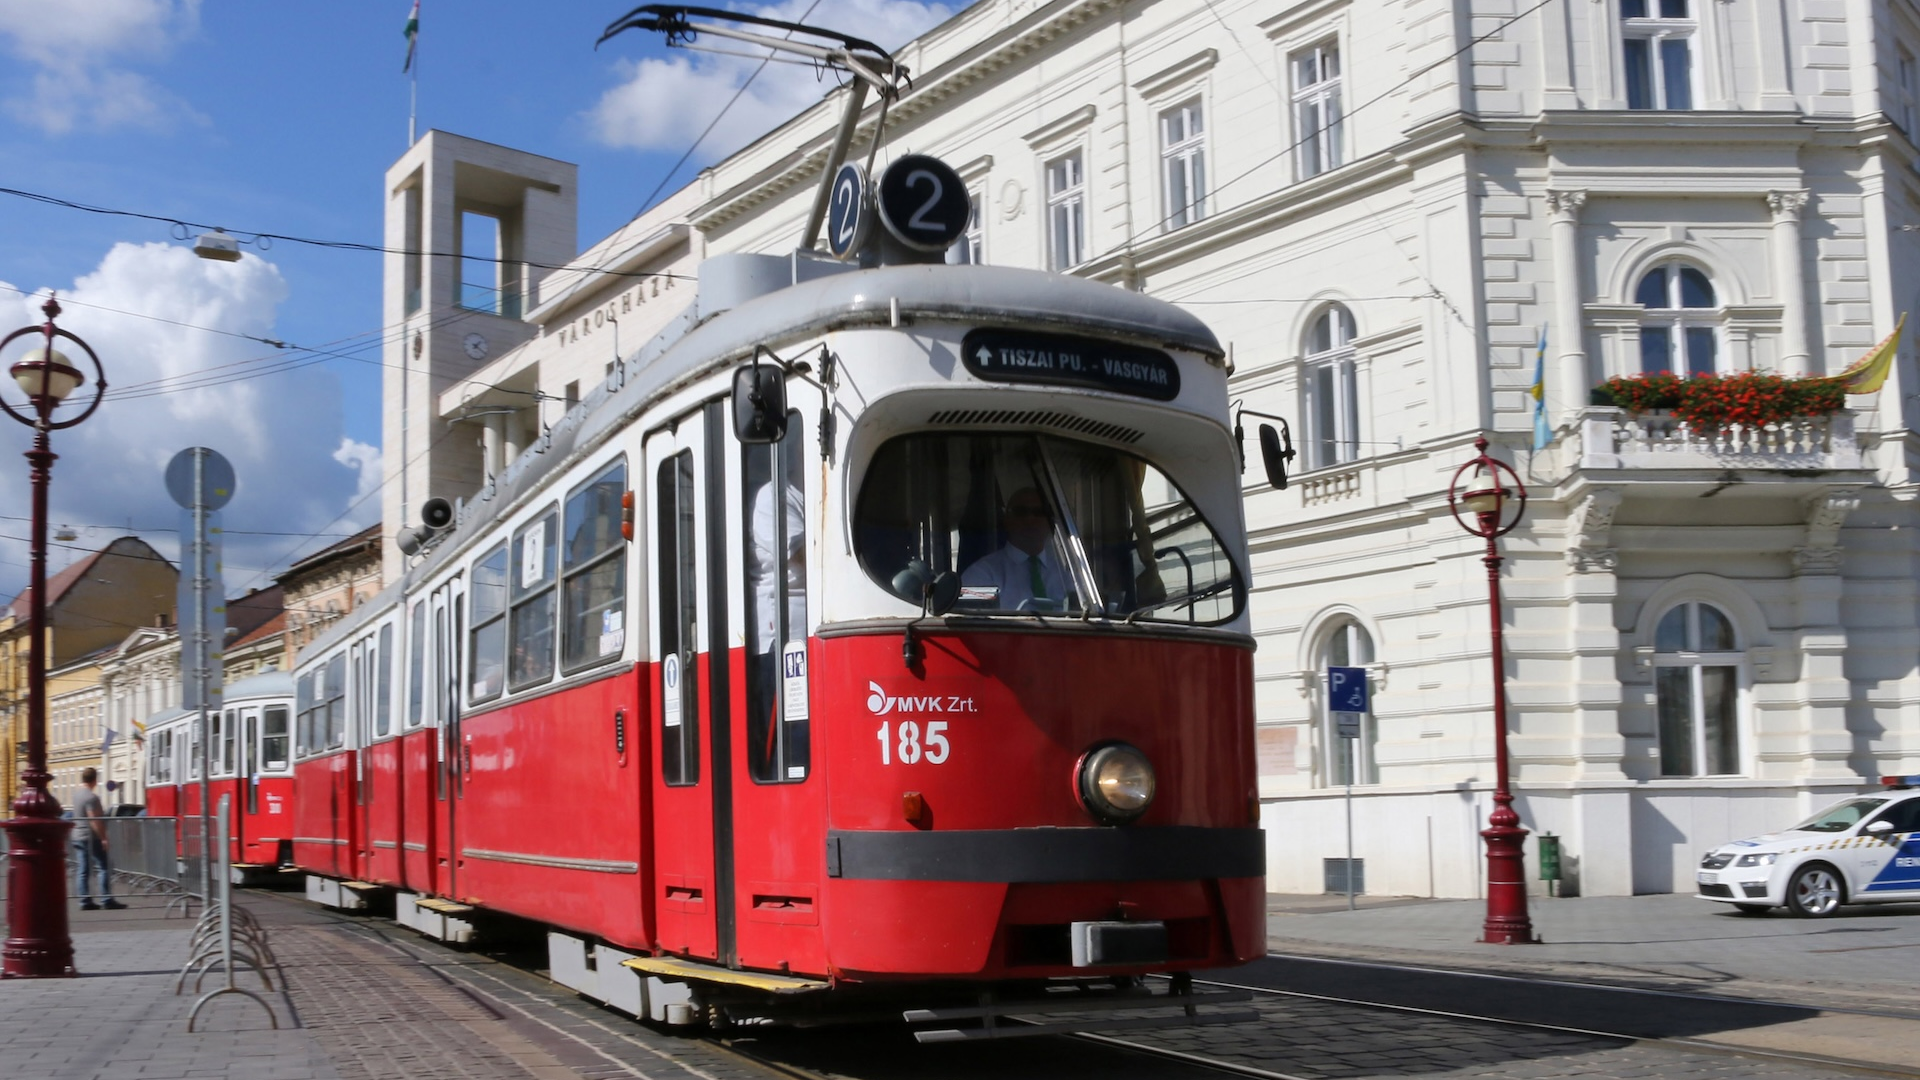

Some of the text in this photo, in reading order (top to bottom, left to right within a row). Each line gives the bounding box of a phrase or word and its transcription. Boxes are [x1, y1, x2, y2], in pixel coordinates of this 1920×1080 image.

[838, 178, 854, 245] 2
[905, 169, 947, 231] 2
[558, 268, 676, 348] VÁROSHÁZA
[1000, 349, 1054, 369] TISZAI
[1059, 352, 1087, 372] PU.
[1103, 358, 1169, 386] VASGYÁR
[897, 696, 979, 713] MVK Zrt.
[1331, 672, 1347, 693] P
[877, 720, 951, 765] 185
